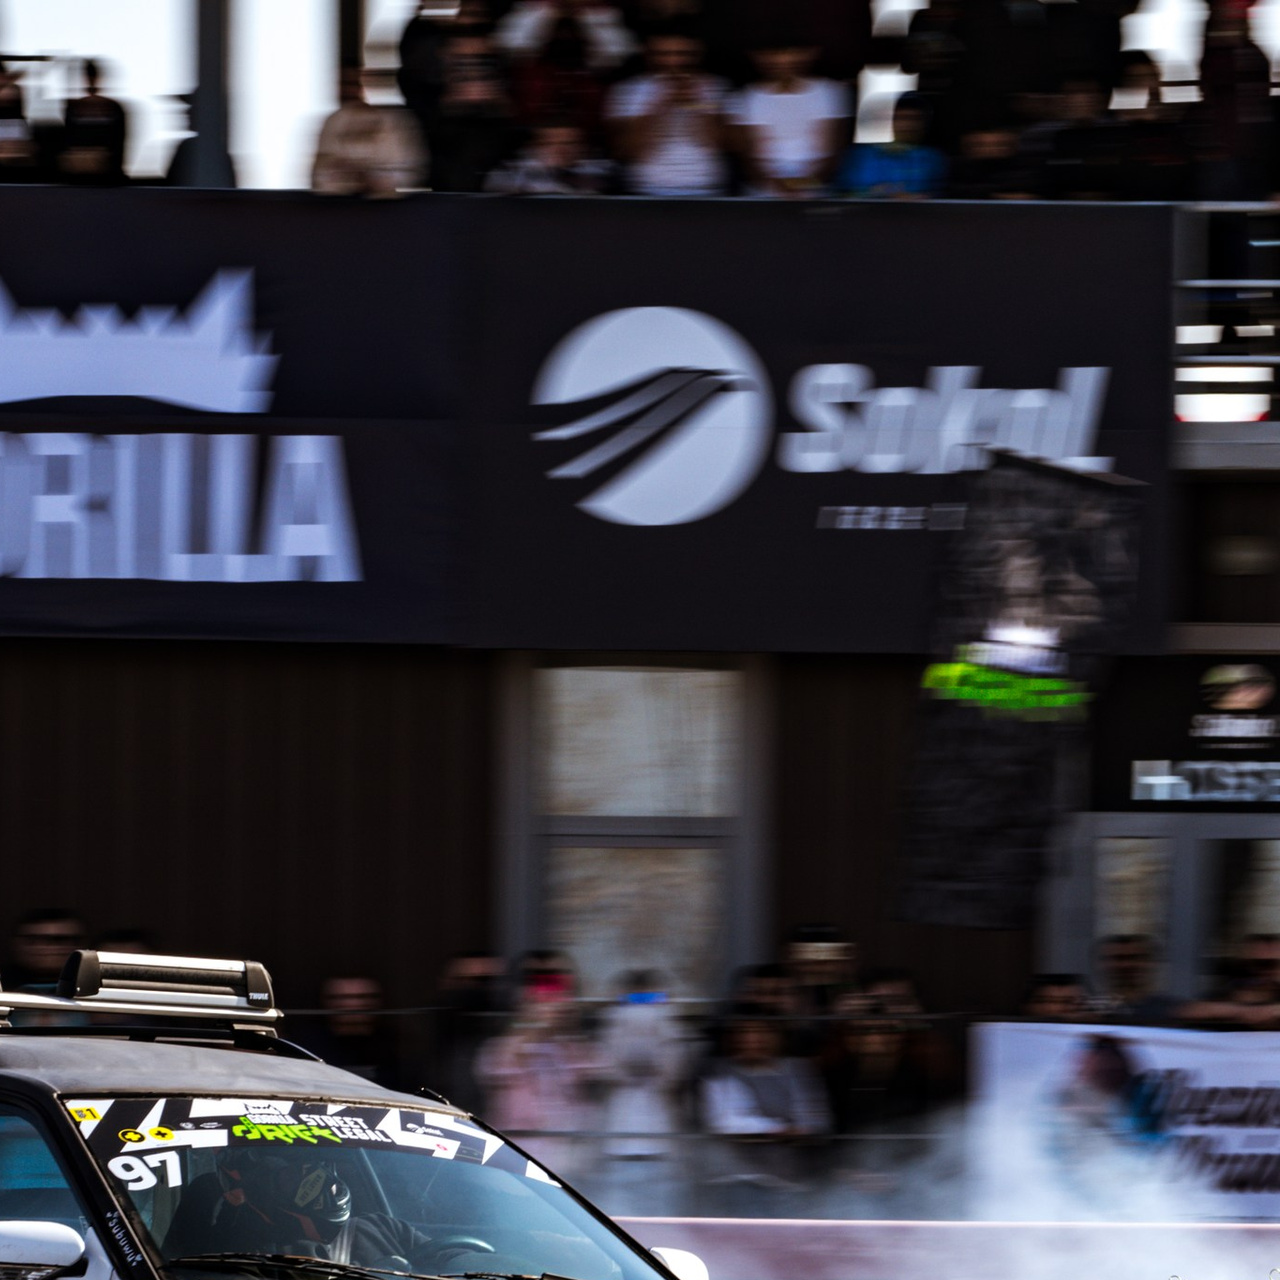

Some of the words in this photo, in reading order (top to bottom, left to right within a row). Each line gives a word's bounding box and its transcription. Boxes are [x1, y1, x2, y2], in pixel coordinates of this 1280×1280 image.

[299, 1114, 369, 1130] STREET
[331, 1127, 392, 1142] LEGAL
[107, 1150, 182, 1191] 97
